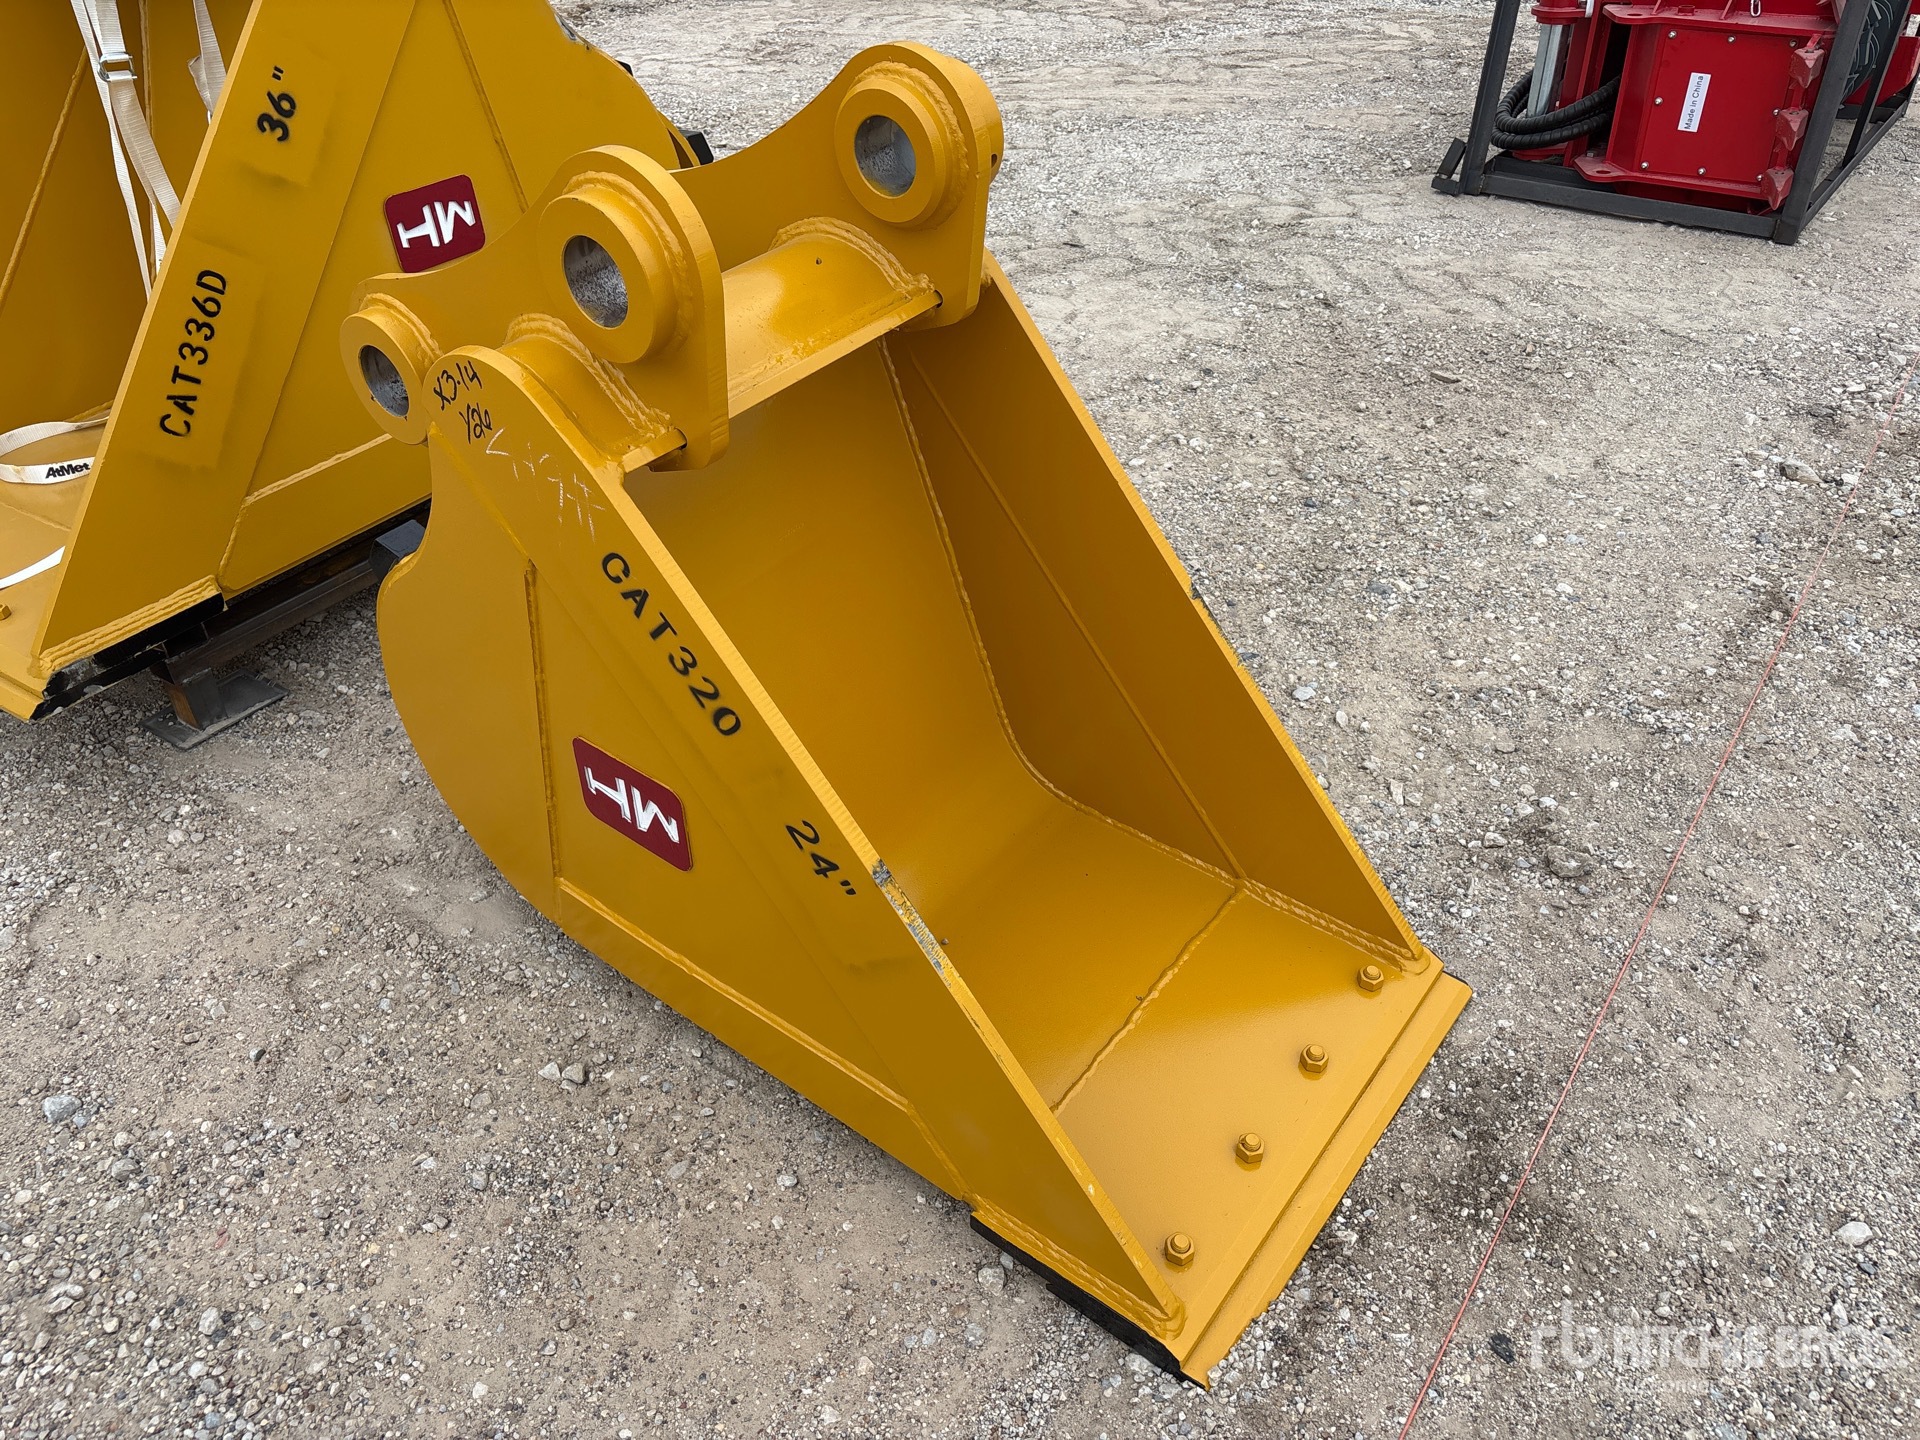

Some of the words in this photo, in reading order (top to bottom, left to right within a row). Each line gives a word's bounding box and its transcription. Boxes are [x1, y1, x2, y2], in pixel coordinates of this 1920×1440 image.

[257, 64, 297, 143] 36"
[1684, 108, 1696, 130] Made
[1689, 99, 1698, 108] in
[1692, 75, 1704, 99] China
[159, 268, 228, 438] CAT336D
[601, 552, 742, 737] CAT320
[786, 819, 857, 896] 24"
